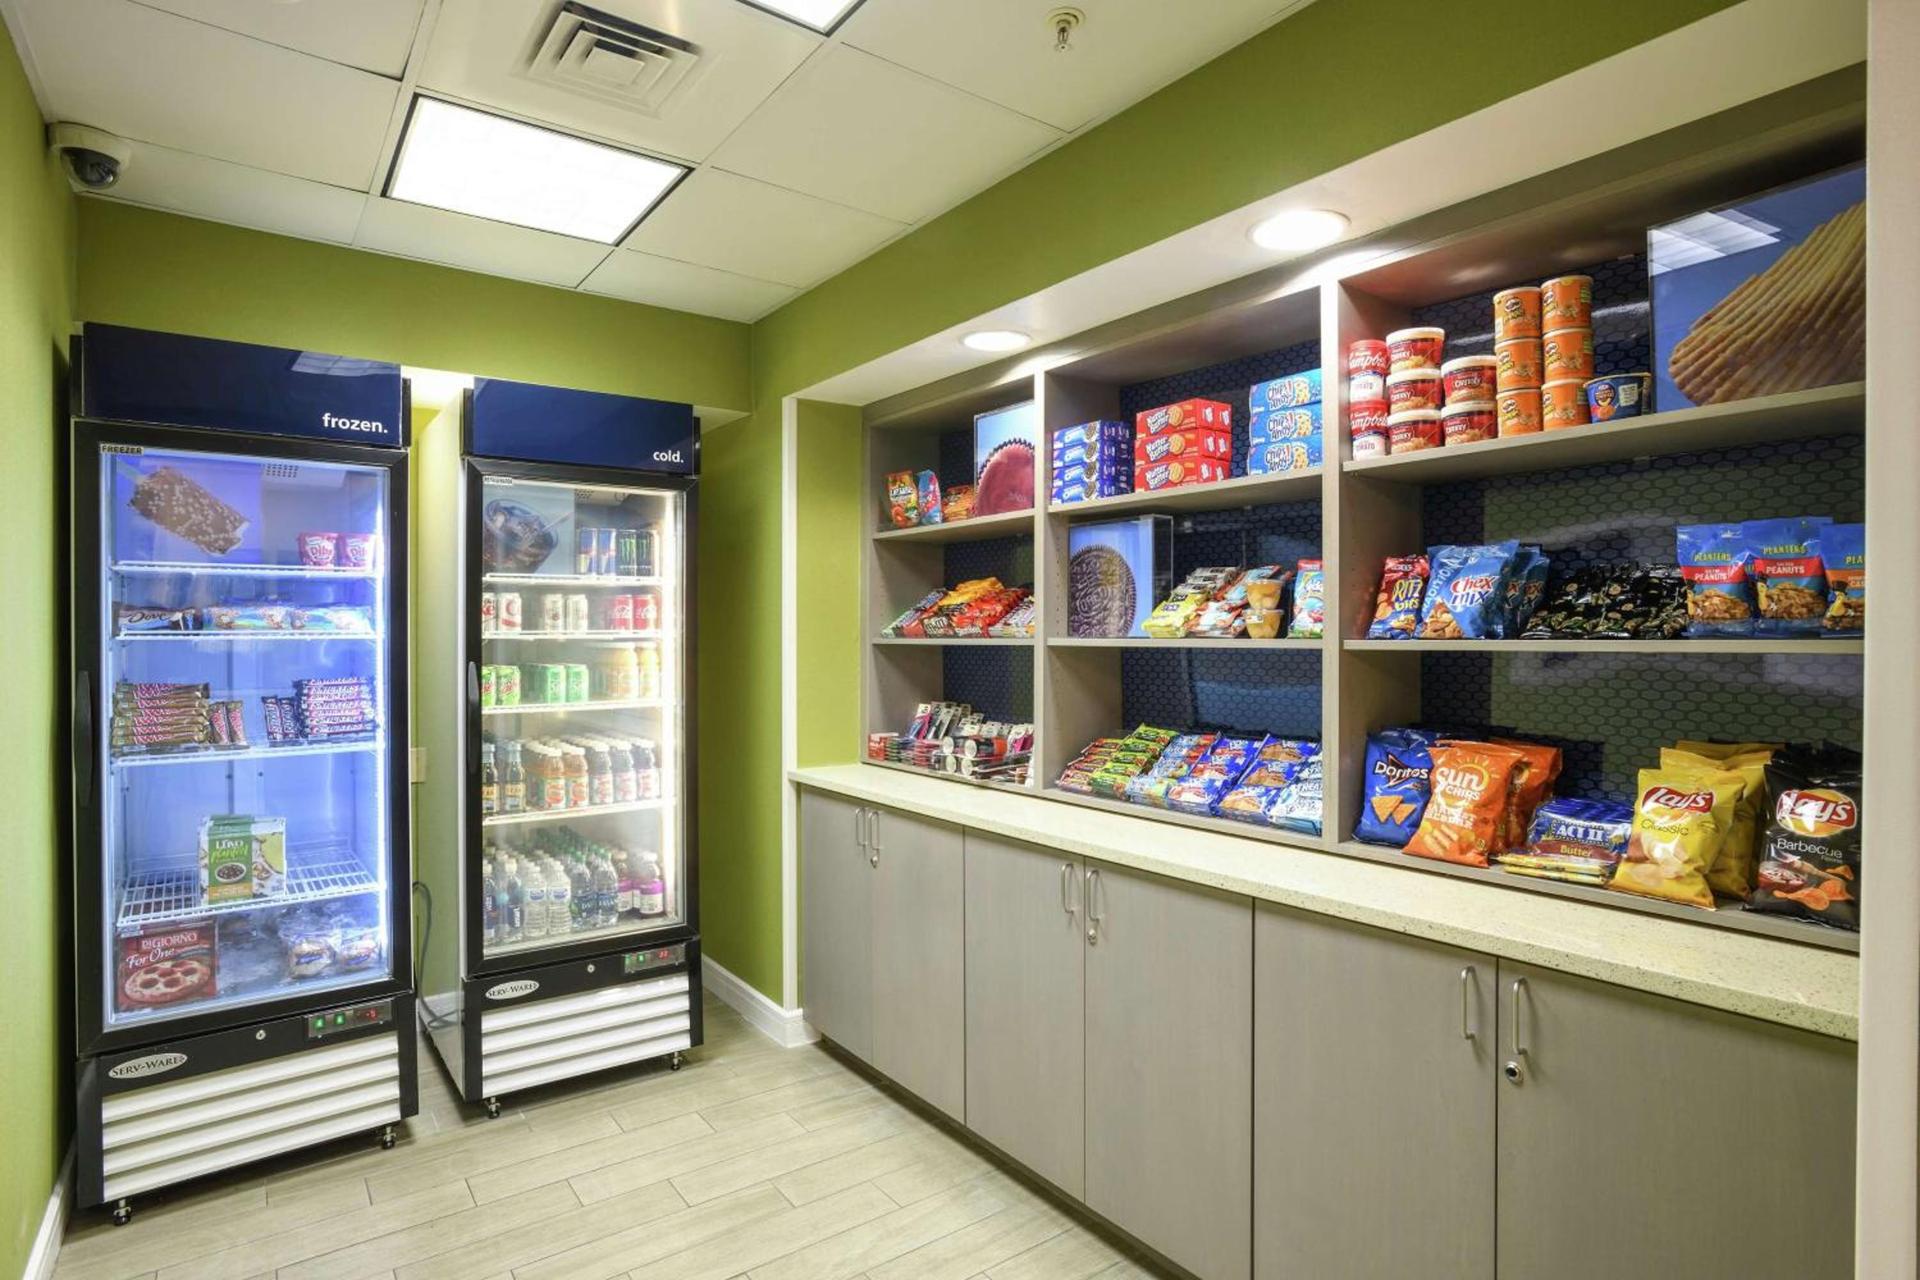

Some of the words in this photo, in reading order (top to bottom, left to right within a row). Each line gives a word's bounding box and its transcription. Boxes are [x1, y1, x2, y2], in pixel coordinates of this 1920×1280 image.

[322, 412, 388, 434] frozen.
[102, 444, 143, 454] FREEZER
[653, 449, 684, 463] cold.
[1695, 573, 1728, 581] PEANUTS
[1766, 566, 1805, 575] PEANUTS
[1391, 578, 1424, 602] RITZ
[1451, 576, 1497, 594] Chex
[1374, 761, 1429, 779] Doritos
[1644, 788, 1712, 810] Lay's
[1779, 790, 1853, 823] Lay's
[1555, 824, 1586, 838] ACT
[1560, 844, 1592, 857] Butter
[1777, 838, 1843, 858] Barbecue
[126, 953, 148, 969] For
[149, 947, 175, 962] One
